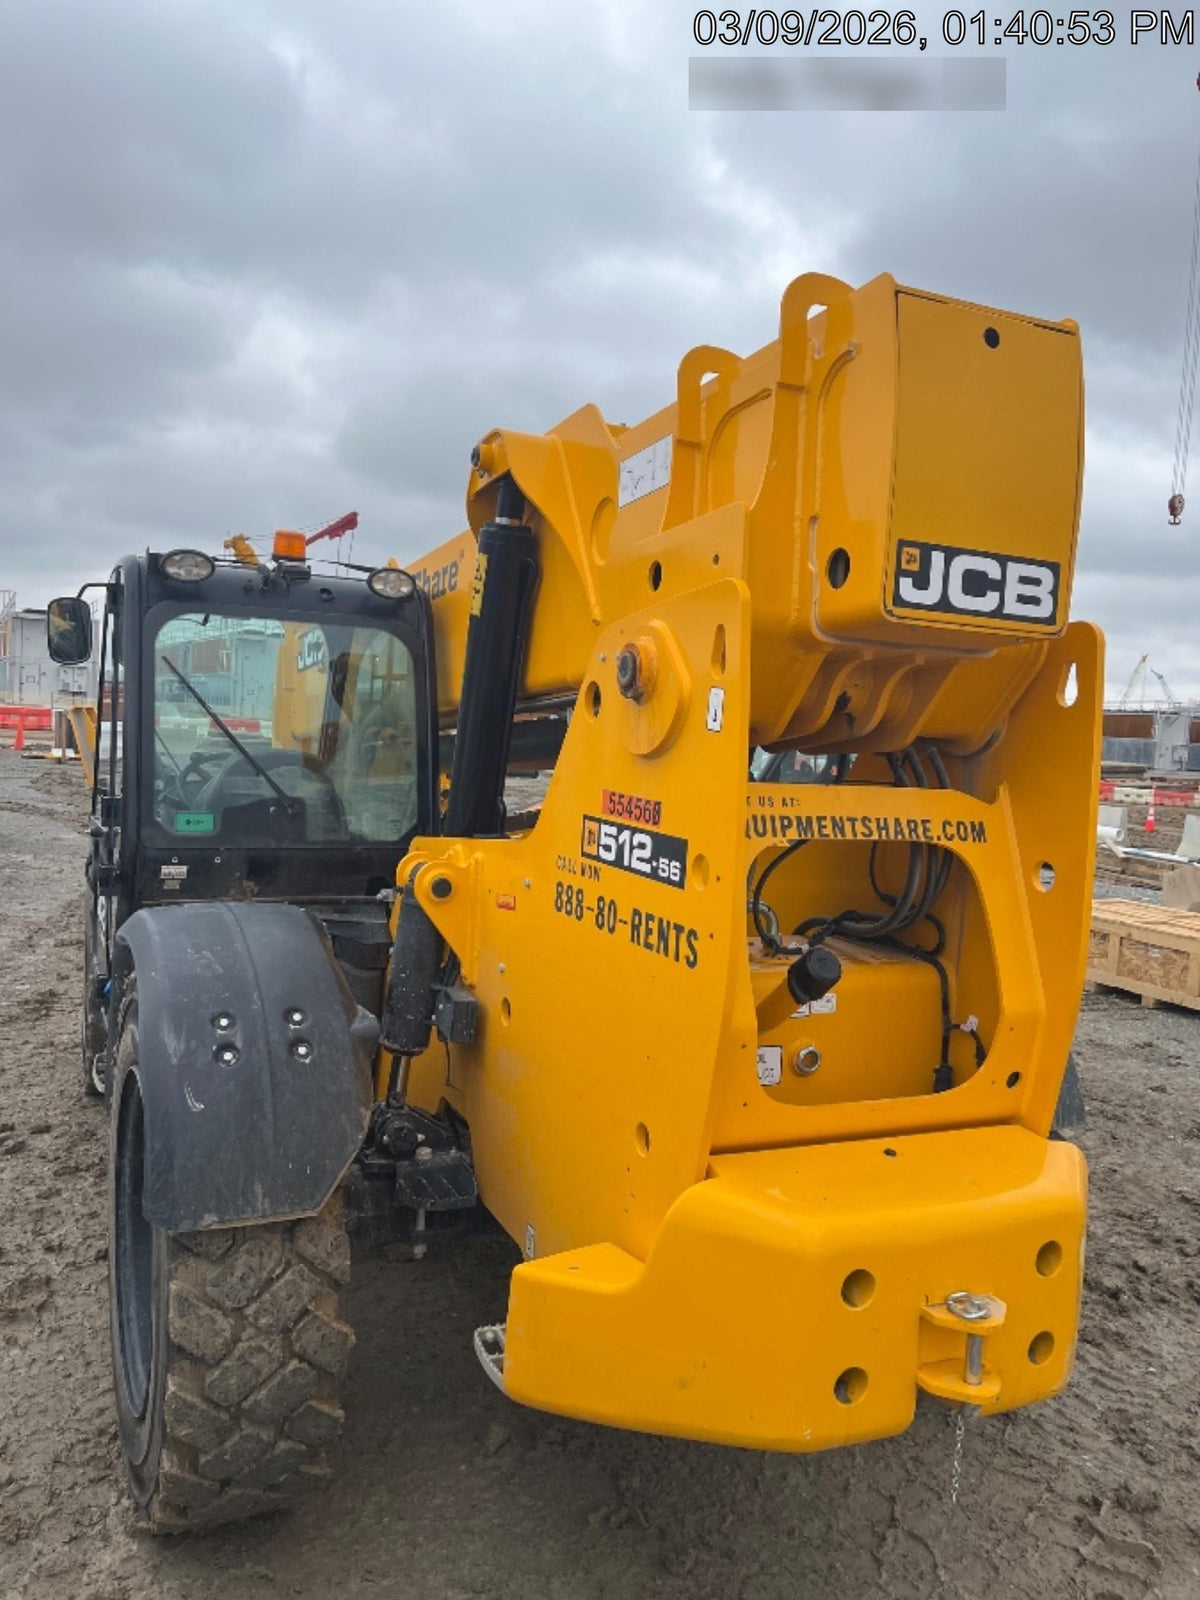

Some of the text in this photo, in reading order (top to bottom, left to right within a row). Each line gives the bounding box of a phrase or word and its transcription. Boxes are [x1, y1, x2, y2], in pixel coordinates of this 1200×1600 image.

[899, 550, 1055, 618] JCB
[608, 791, 663, 826] 554560
[757, 796, 775, 808] US
[554, 881, 700, 969] 888-80-RENTS
